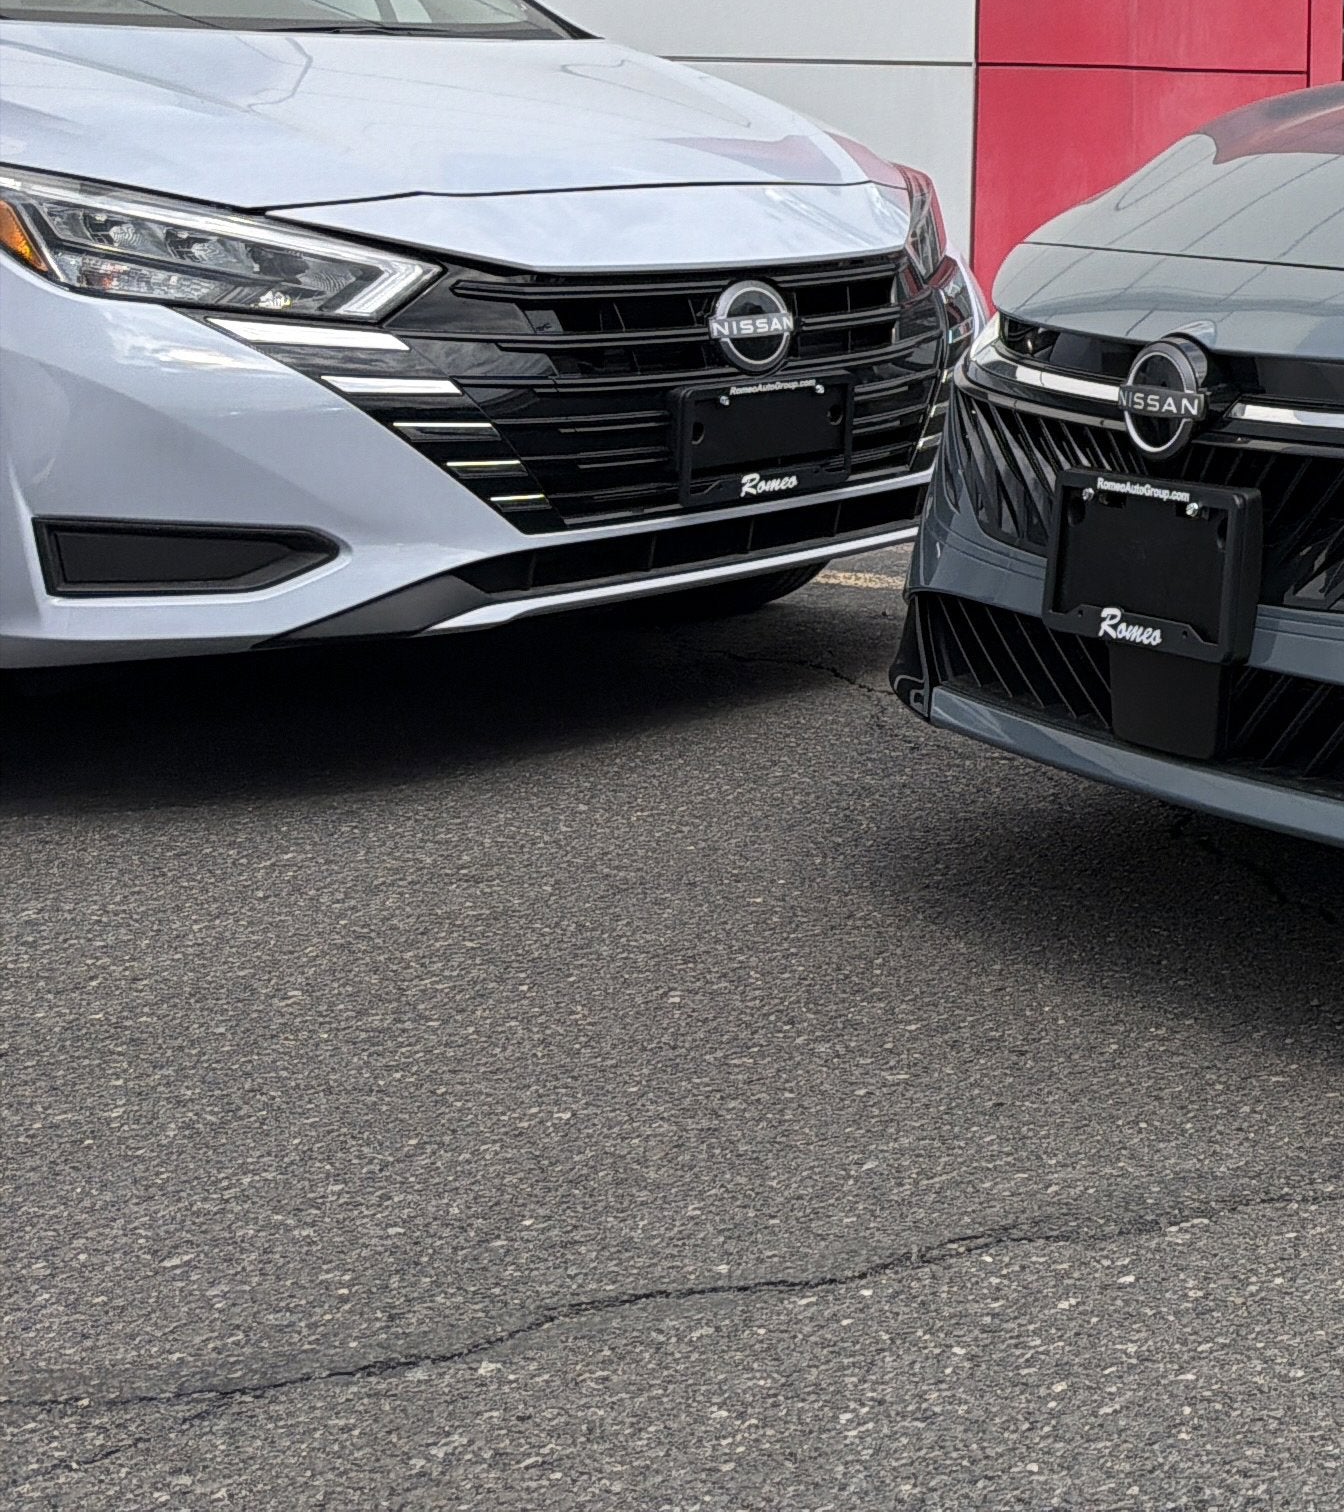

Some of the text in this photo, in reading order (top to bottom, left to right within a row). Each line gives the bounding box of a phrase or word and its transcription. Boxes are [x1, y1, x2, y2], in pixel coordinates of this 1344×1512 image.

[711, 314, 794, 337] NISSAN
[1119, 389, 1199, 416] NISSAN
[740, 472, 798, 497] Romeo
[1096, 476, 1190, 502] RomeoAutoGroup.com
[1098, 606, 1162, 647] Romeo
